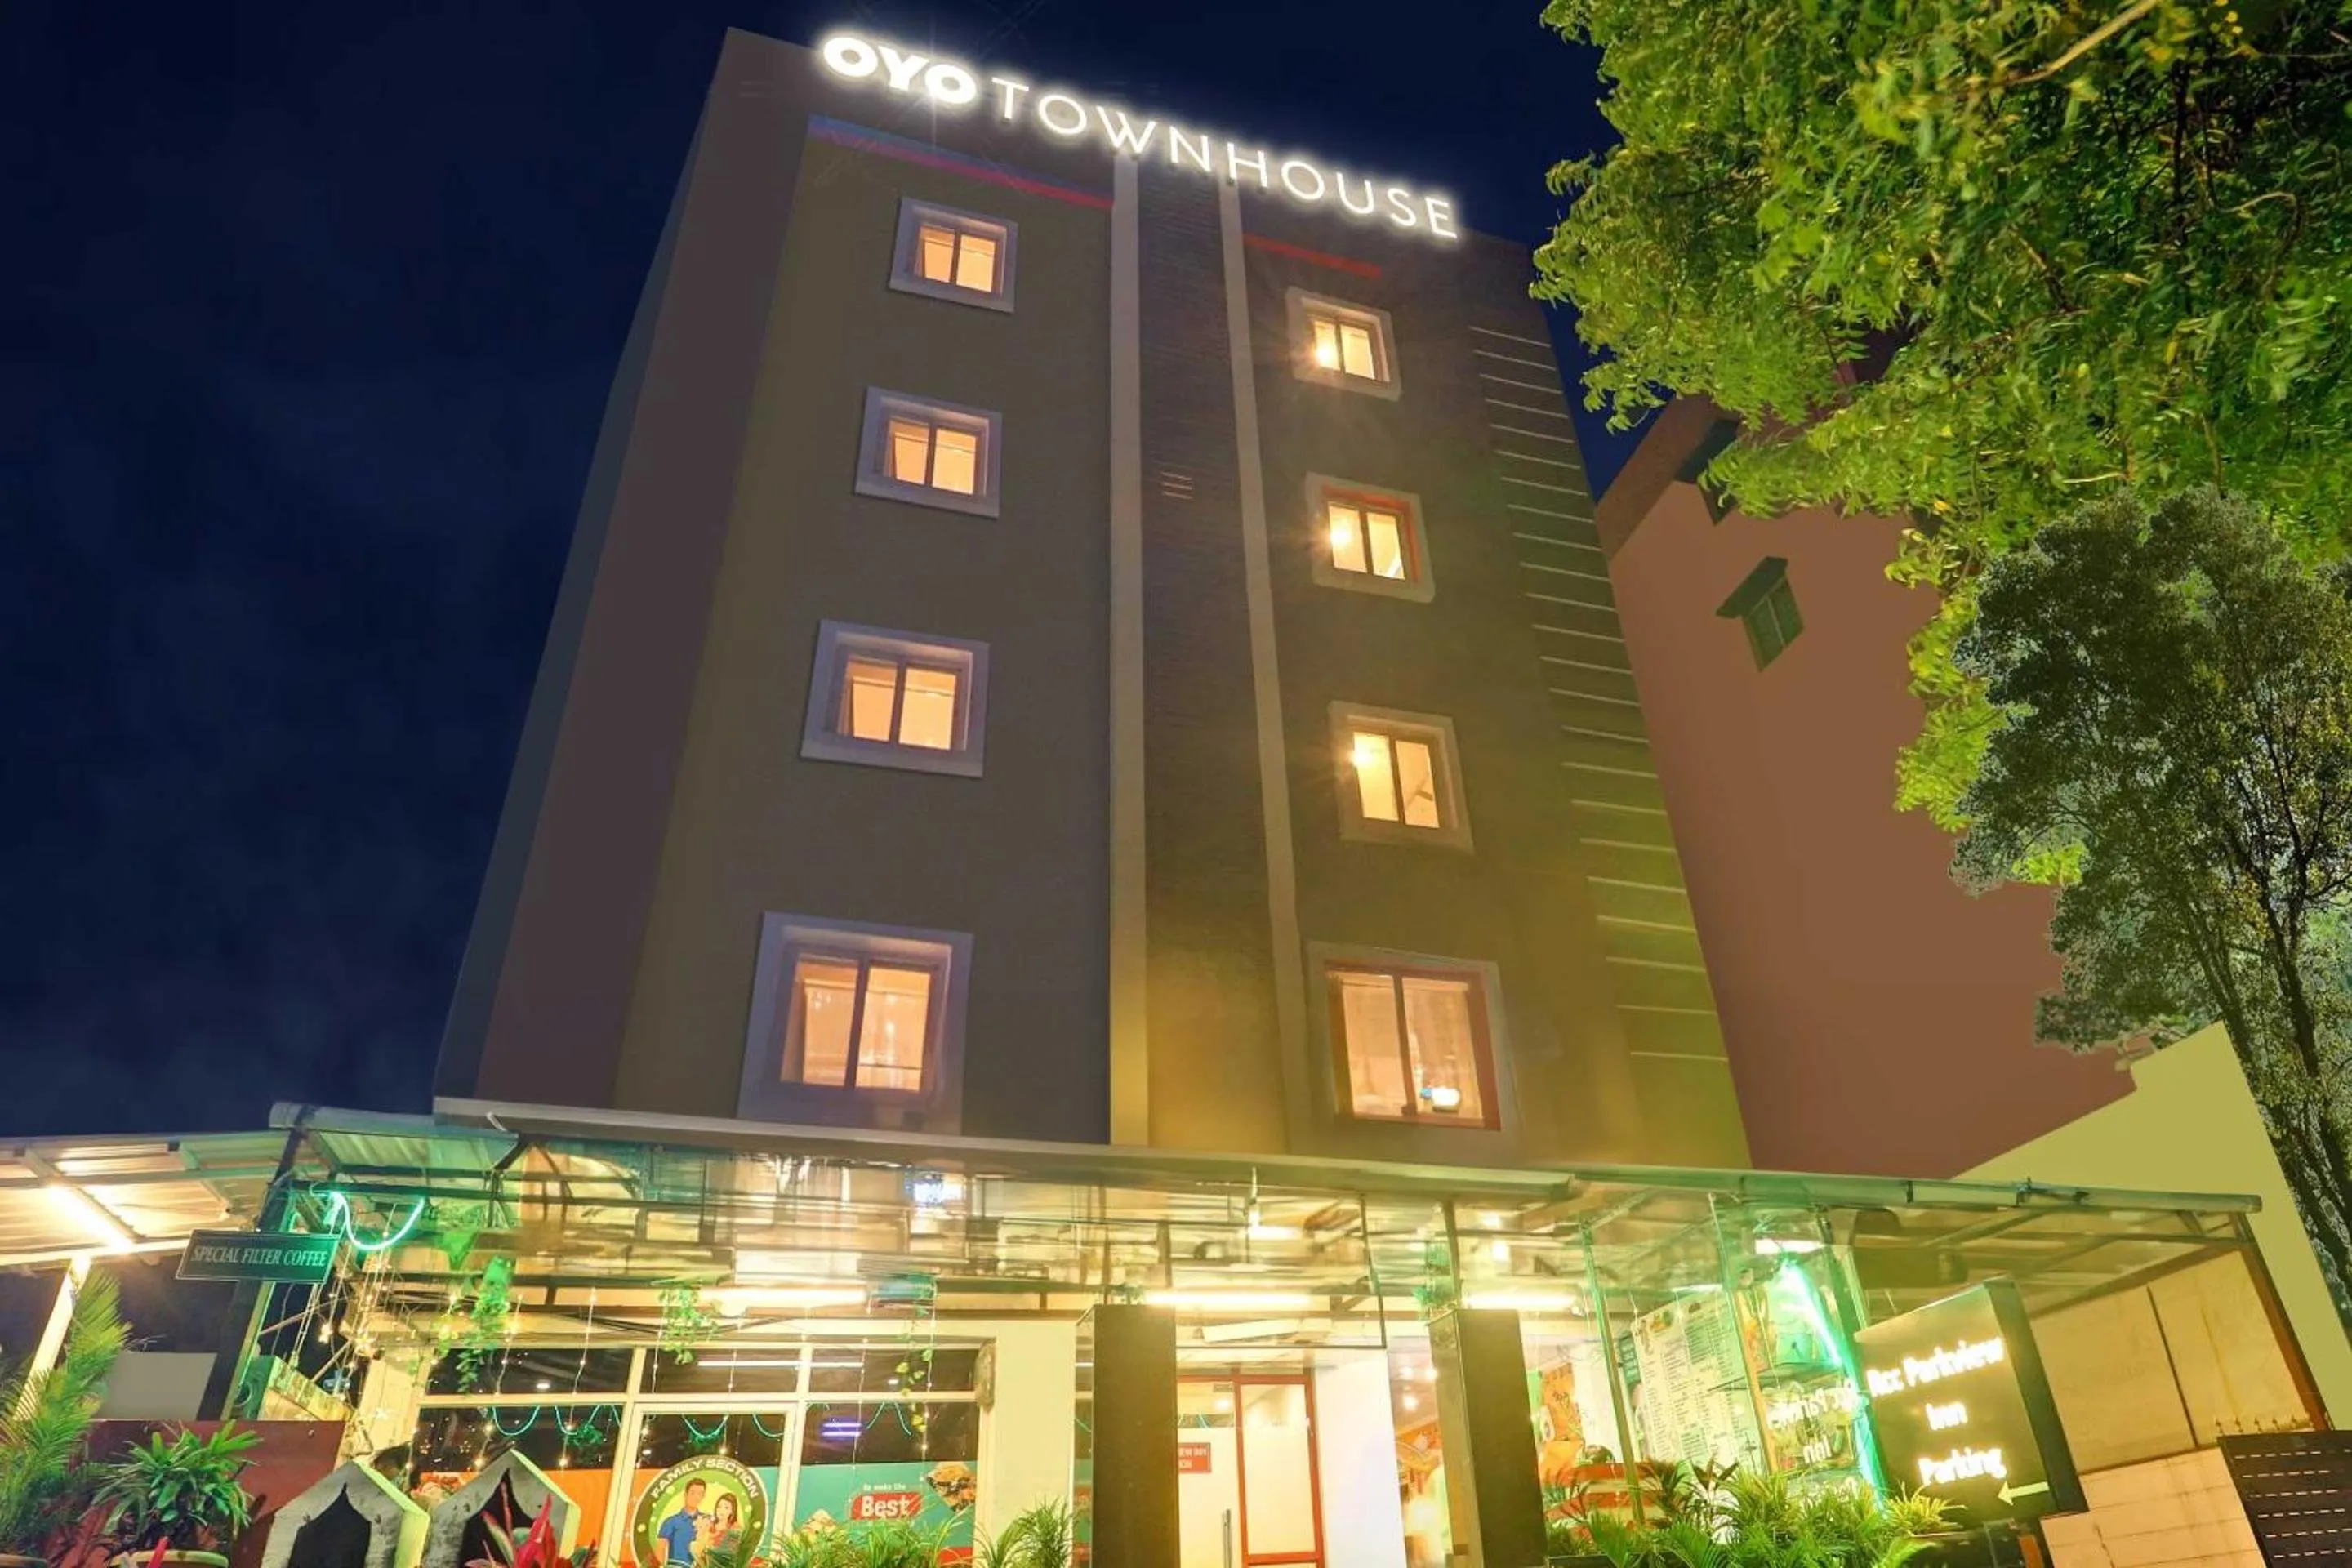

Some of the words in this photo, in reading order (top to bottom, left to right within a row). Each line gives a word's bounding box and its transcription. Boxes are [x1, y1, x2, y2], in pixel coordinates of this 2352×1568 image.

[822, 37, 978, 105] OYO
[991, 77, 1459, 239] TOWNHOUSE
[191, 1246, 240, 1264] SPECIAL
[240, 1248, 280, 1265] FILTER
[283, 1250, 327, 1267] COFFEE
[1903, 1336, 2004, 1388] Parkview
[1925, 1403, 1968, 1431] Inn
[651, 1459, 702, 1499] FAMILY
[705, 1458, 759, 1499] SECTION
[1918, 1446, 2007, 1486] Parking
[861, 1494, 910, 1518] Best
